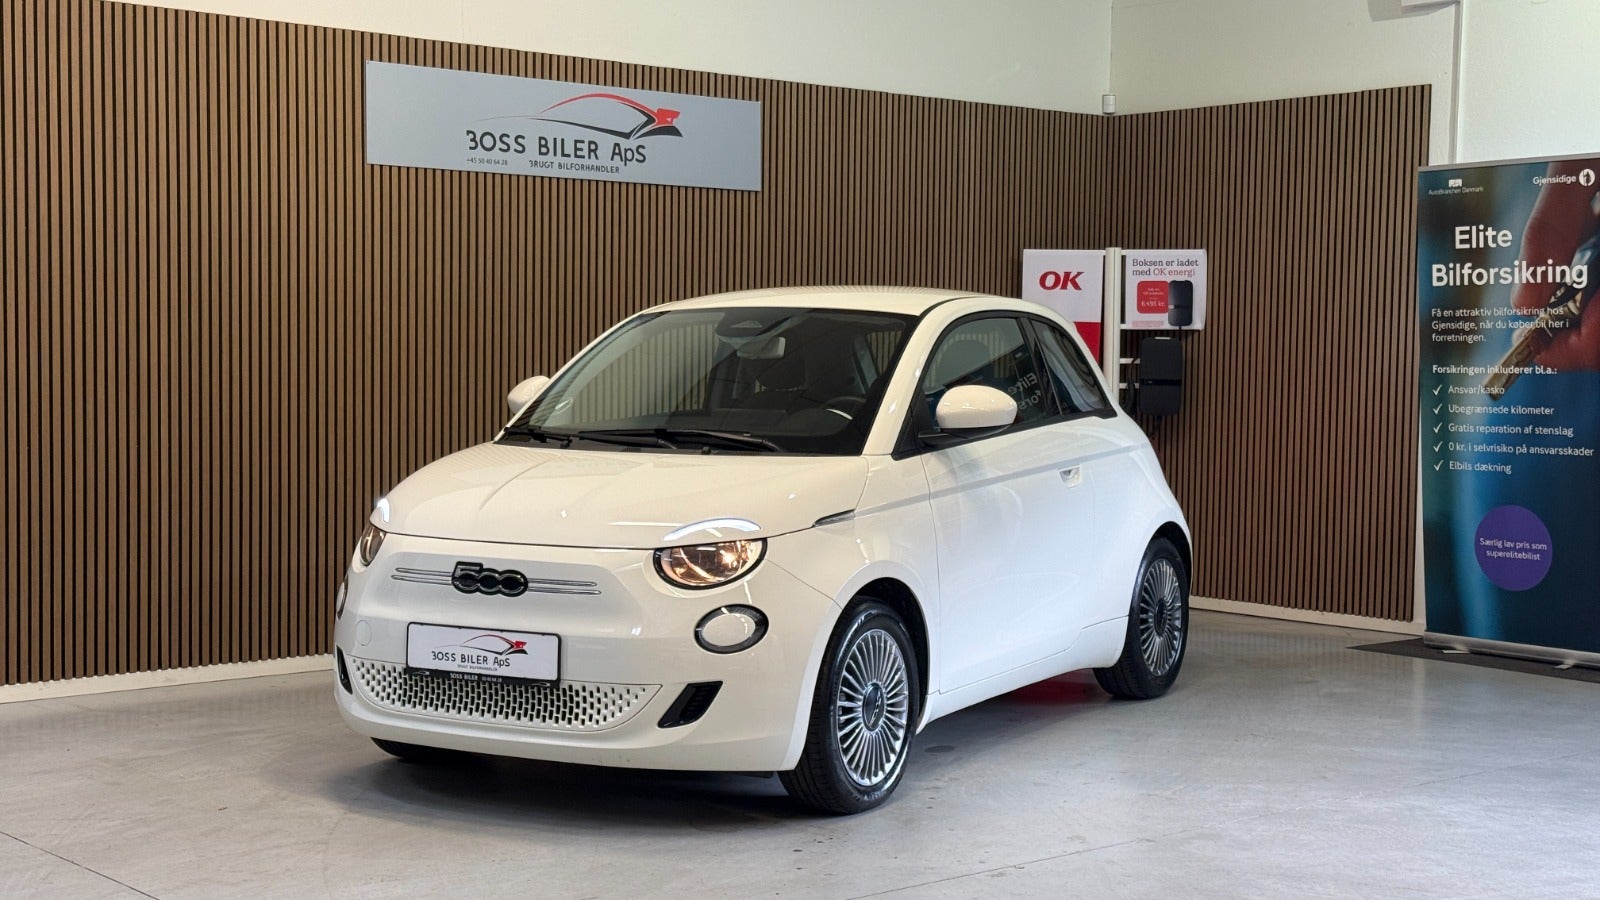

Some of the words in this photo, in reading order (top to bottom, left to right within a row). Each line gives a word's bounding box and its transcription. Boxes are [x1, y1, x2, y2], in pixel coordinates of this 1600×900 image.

[538, 136, 599, 160] BILER
[610, 142, 647, 167] ApS
[558, 162, 620, 174] BILFORHANDLER
[1533, 174, 1577, 186] Gjensidige
[1455, 224, 1513, 250] Elite
[1132, 258, 1164, 267] Boksen
[1176, 258, 1199, 267] ladet
[1132, 268, 1151, 276] med
[1153, 268, 1167, 276] OK
[1168, 268, 1196, 278] energi
[1431, 259, 1588, 289] Bilforsikring
[1039, 270, 1084, 291] OK
[1431, 308, 1442, 318] Få
[1455, 307, 1491, 317] attraktiv
[1493, 307, 1545, 316] bilforsikring
[1547, 306, 1564, 315] hos
[1431, 321, 1478, 331] Gjensidige,
[1480, 320, 1494, 329] når
[1495, 320, 1507, 329] du
[1508, 319, 1535, 329] køber
[1535, 318, 1546, 328] bil
[1548, 318, 1564, 328] her
[1432, 333, 1487, 344] forretningen.
[1432, 365, 1485, 375] Forsikringen
[1487, 364, 1533, 374] inkluderer
[1448, 385, 1505, 395] Ansvar/kasko
[1448, 404, 1509, 415] Ubegrænsede
[1511, 406, 1555, 415] kilometer
[1448, 423, 1474, 433] Gratis
[1475, 425, 1522, 434] reparation
[1523, 426, 1533, 435] af
[1535, 426, 1574, 437] stenslag
[1448, 442, 1455, 451] 0
[1456, 443, 1467, 451] kr.
[1473, 443, 1514, 453] selvrisiko
[1515, 444, 1528, 454] på
[1529, 446, 1594, 457] ansvarsskader
[1449, 461, 1473, 471] Elbils
[1474, 463, 1512, 474] dækning
[1479, 537, 1503, 548] Særlig
[1503, 540, 1515, 548] lav
[1515, 541, 1530, 549] pris
[1486, 550, 1541, 560] superelitebilist
[452, 561, 528, 597] 500
[460, 653, 488, 665] BILER
[492, 655, 511, 668] ApS
